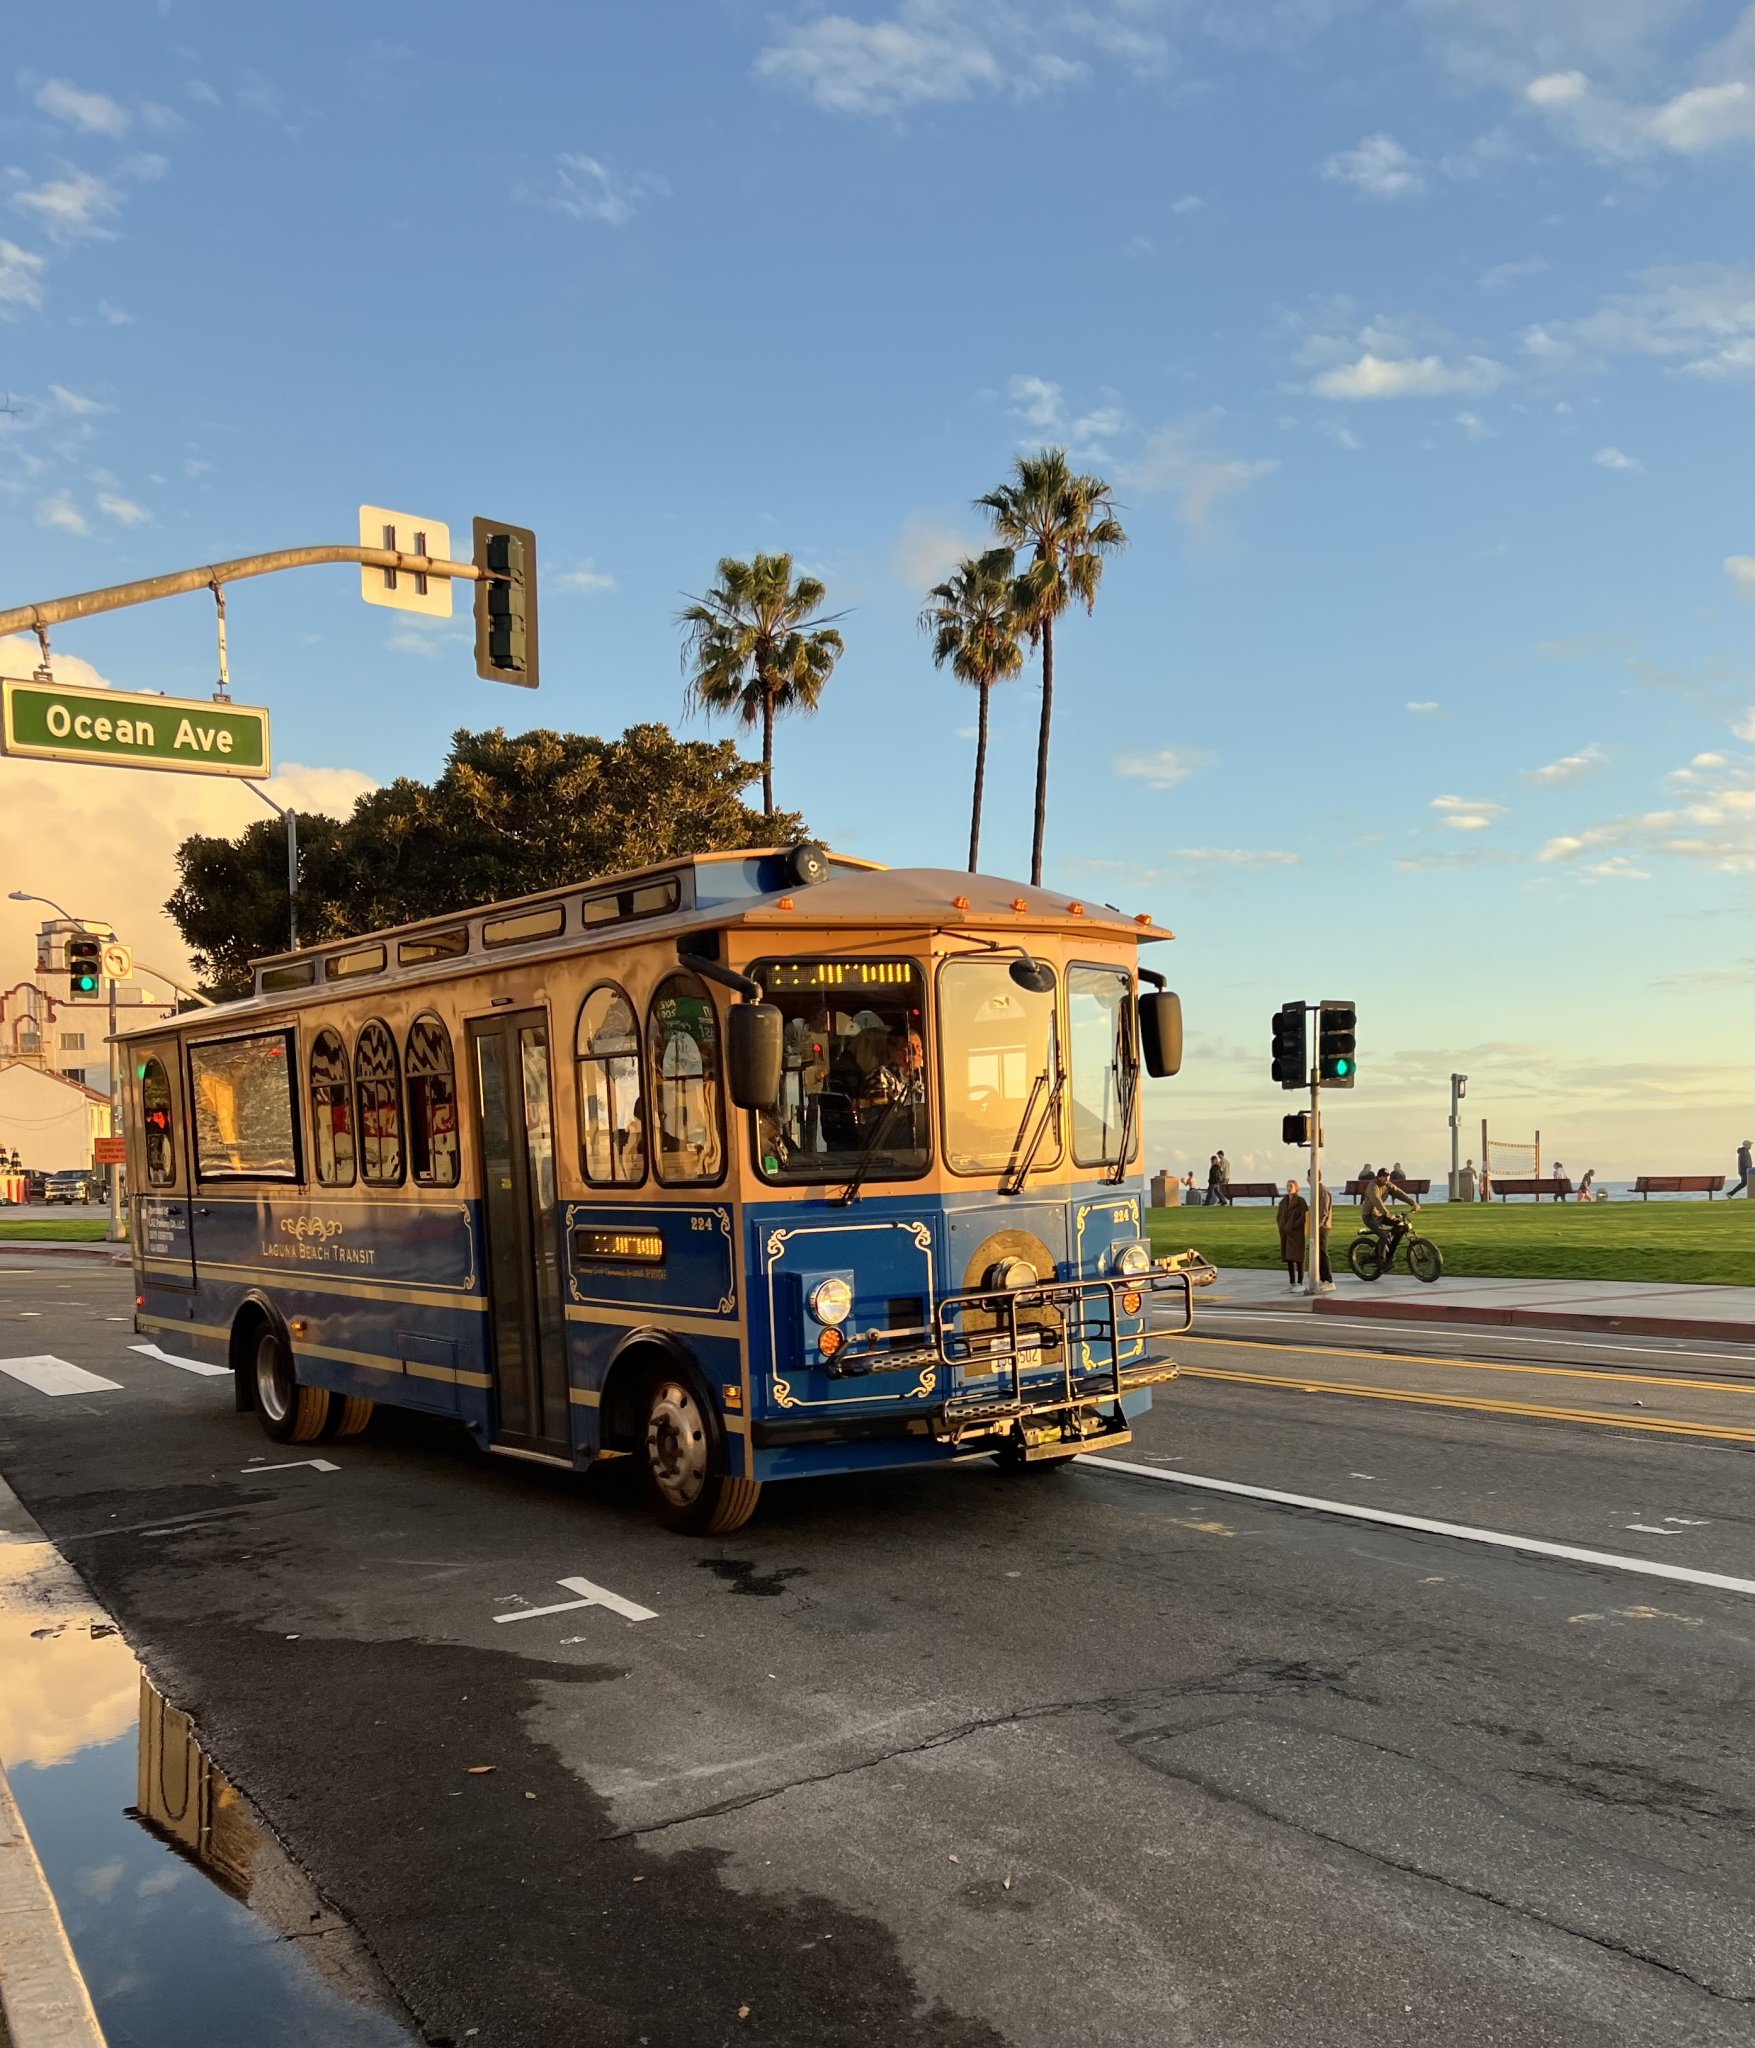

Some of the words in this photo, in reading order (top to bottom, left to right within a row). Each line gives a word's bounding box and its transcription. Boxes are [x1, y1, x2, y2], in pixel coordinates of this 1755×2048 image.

[46, 705, 155, 746] Ocean
[173, 719, 233, 753] Ave
[690, 1217, 713, 1231] 224
[1113, 1209, 1130, 1224] 224
[262, 1241, 297, 1259] LAGUNA
[299, 1243, 330, 1261] BEACH
[332, 1245, 375, 1264] TRANSIT
